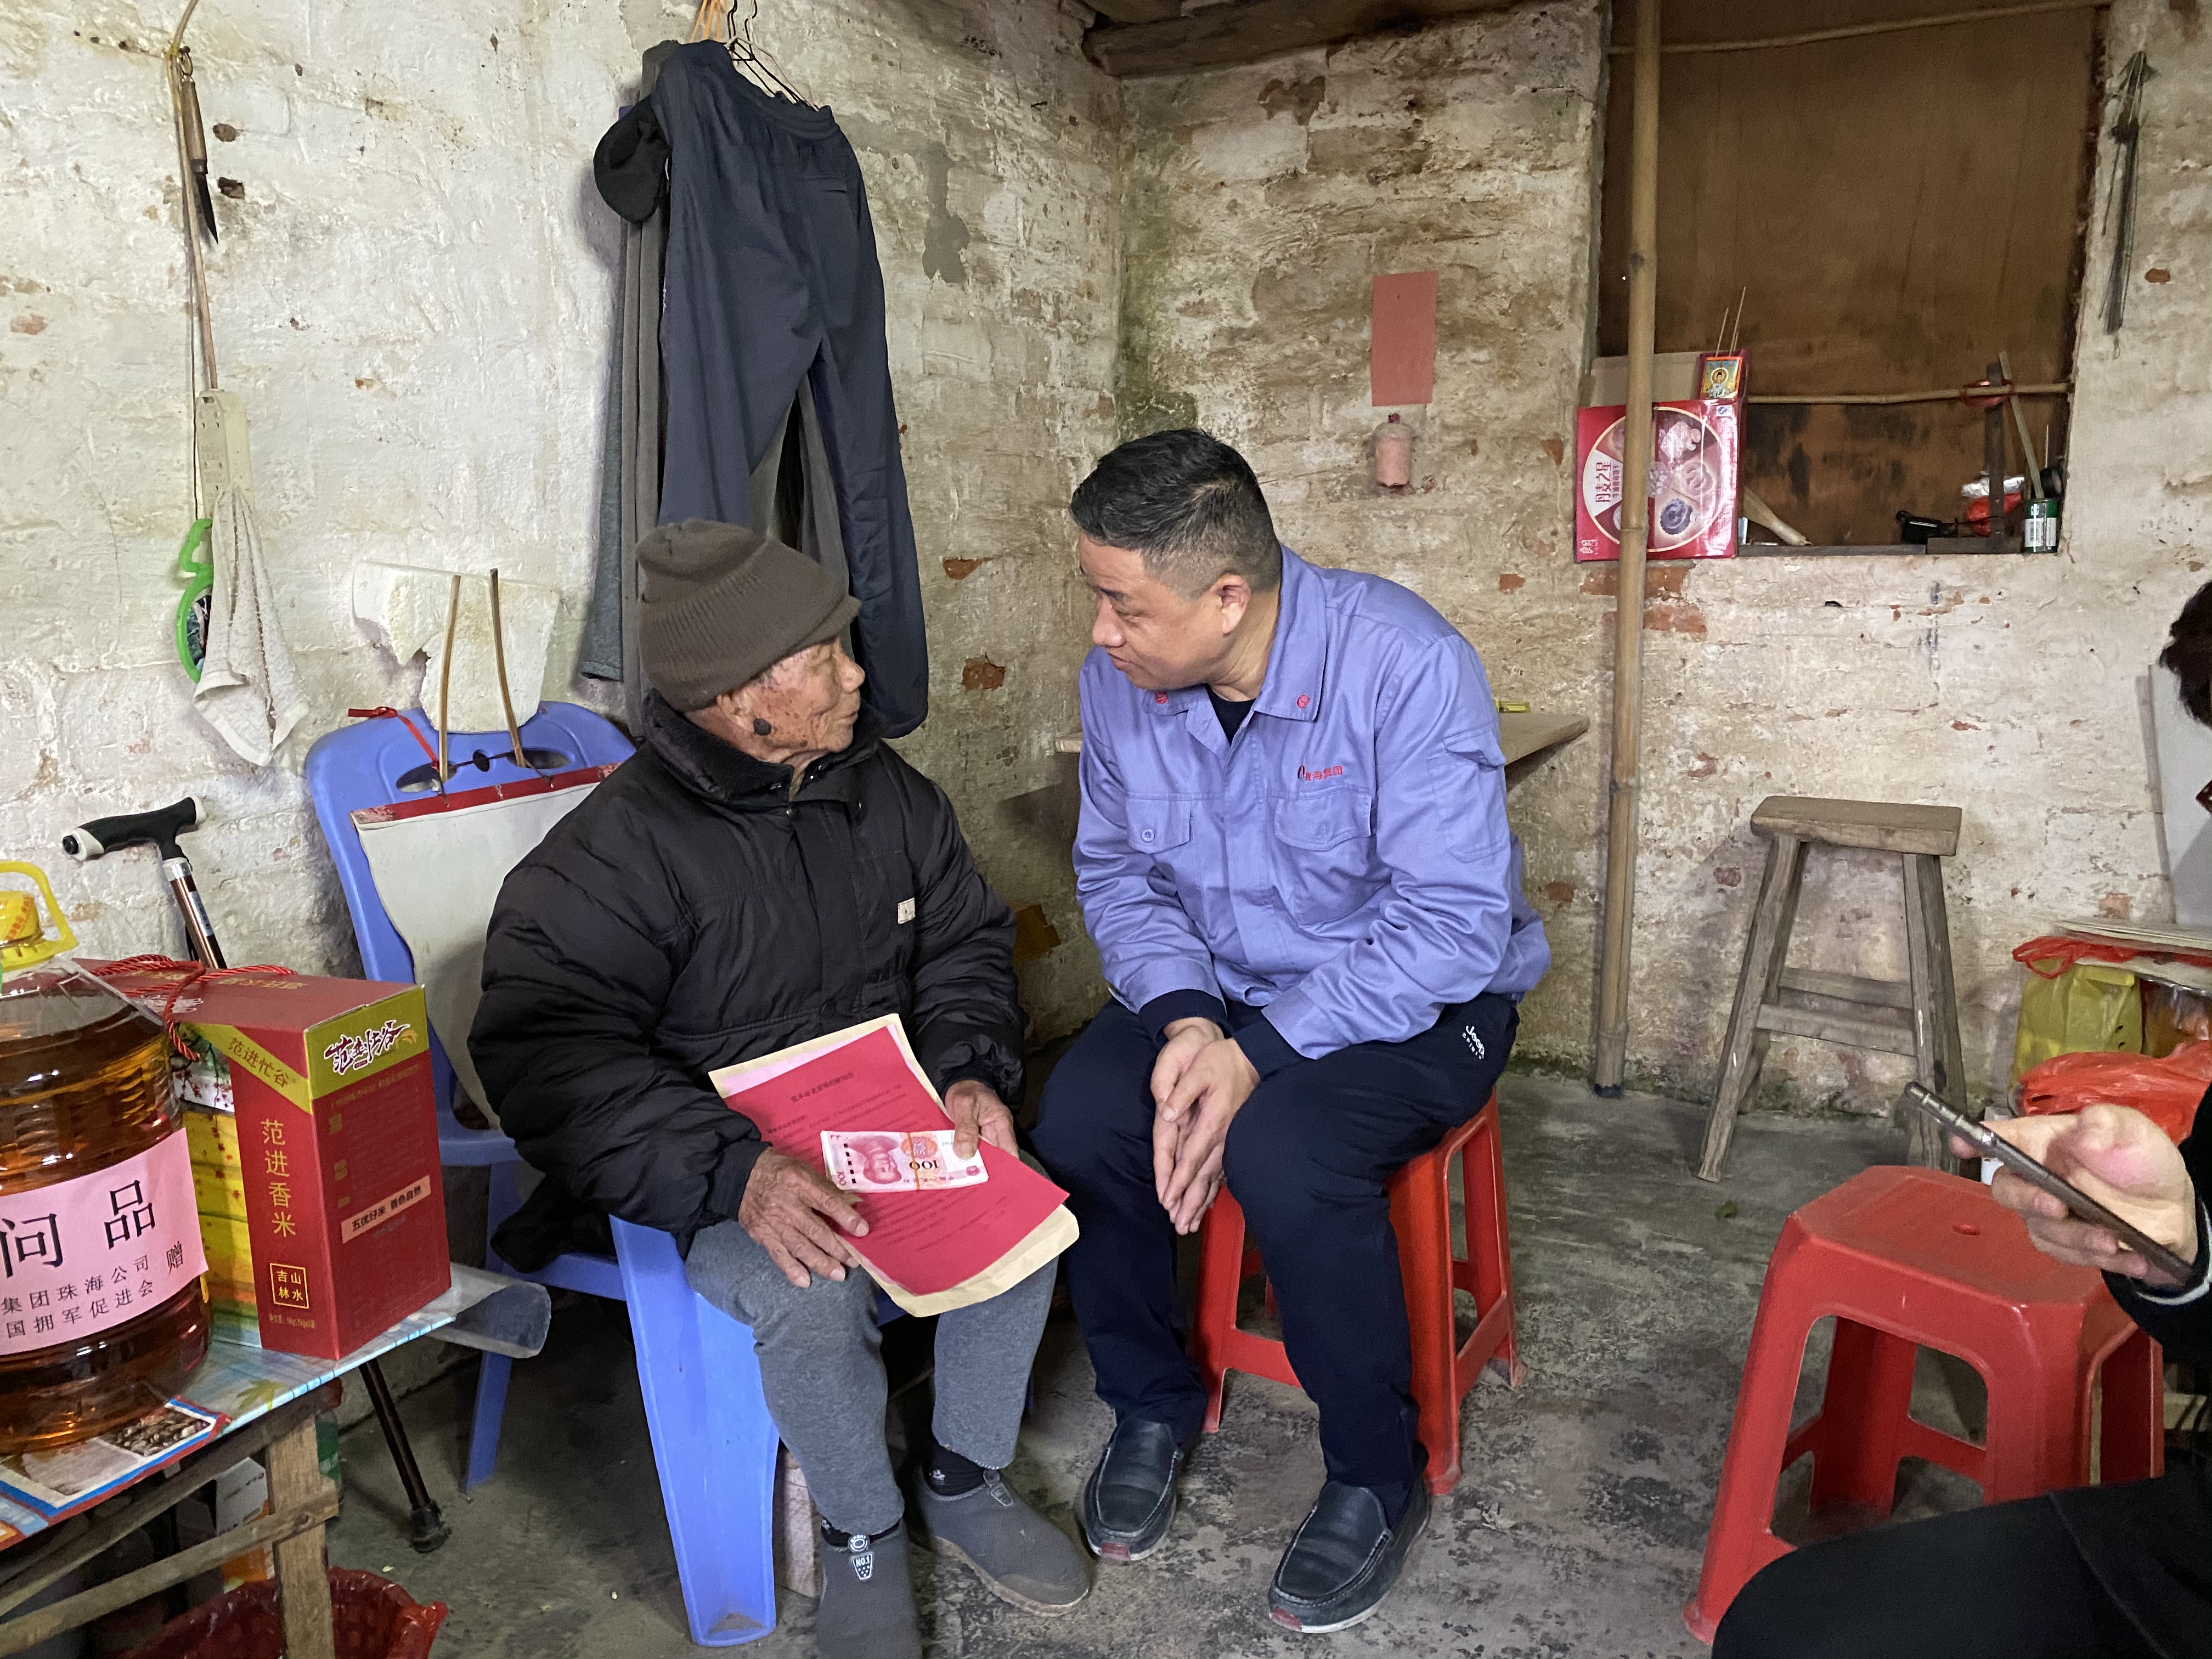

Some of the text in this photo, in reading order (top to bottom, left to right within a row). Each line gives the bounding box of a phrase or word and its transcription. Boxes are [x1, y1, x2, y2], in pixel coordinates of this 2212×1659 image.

[228, 1037, 289, 1088] 范进忙谷
[261, 1118, 296, 1237] 范进香米
[909, 1159, 939, 1172] 100
[1, 1255, 149, 1314] 集团珠海公司
[166, 1241, 183, 1275] 赠
[7, 1279, 154, 1339] 国拥军促进会
